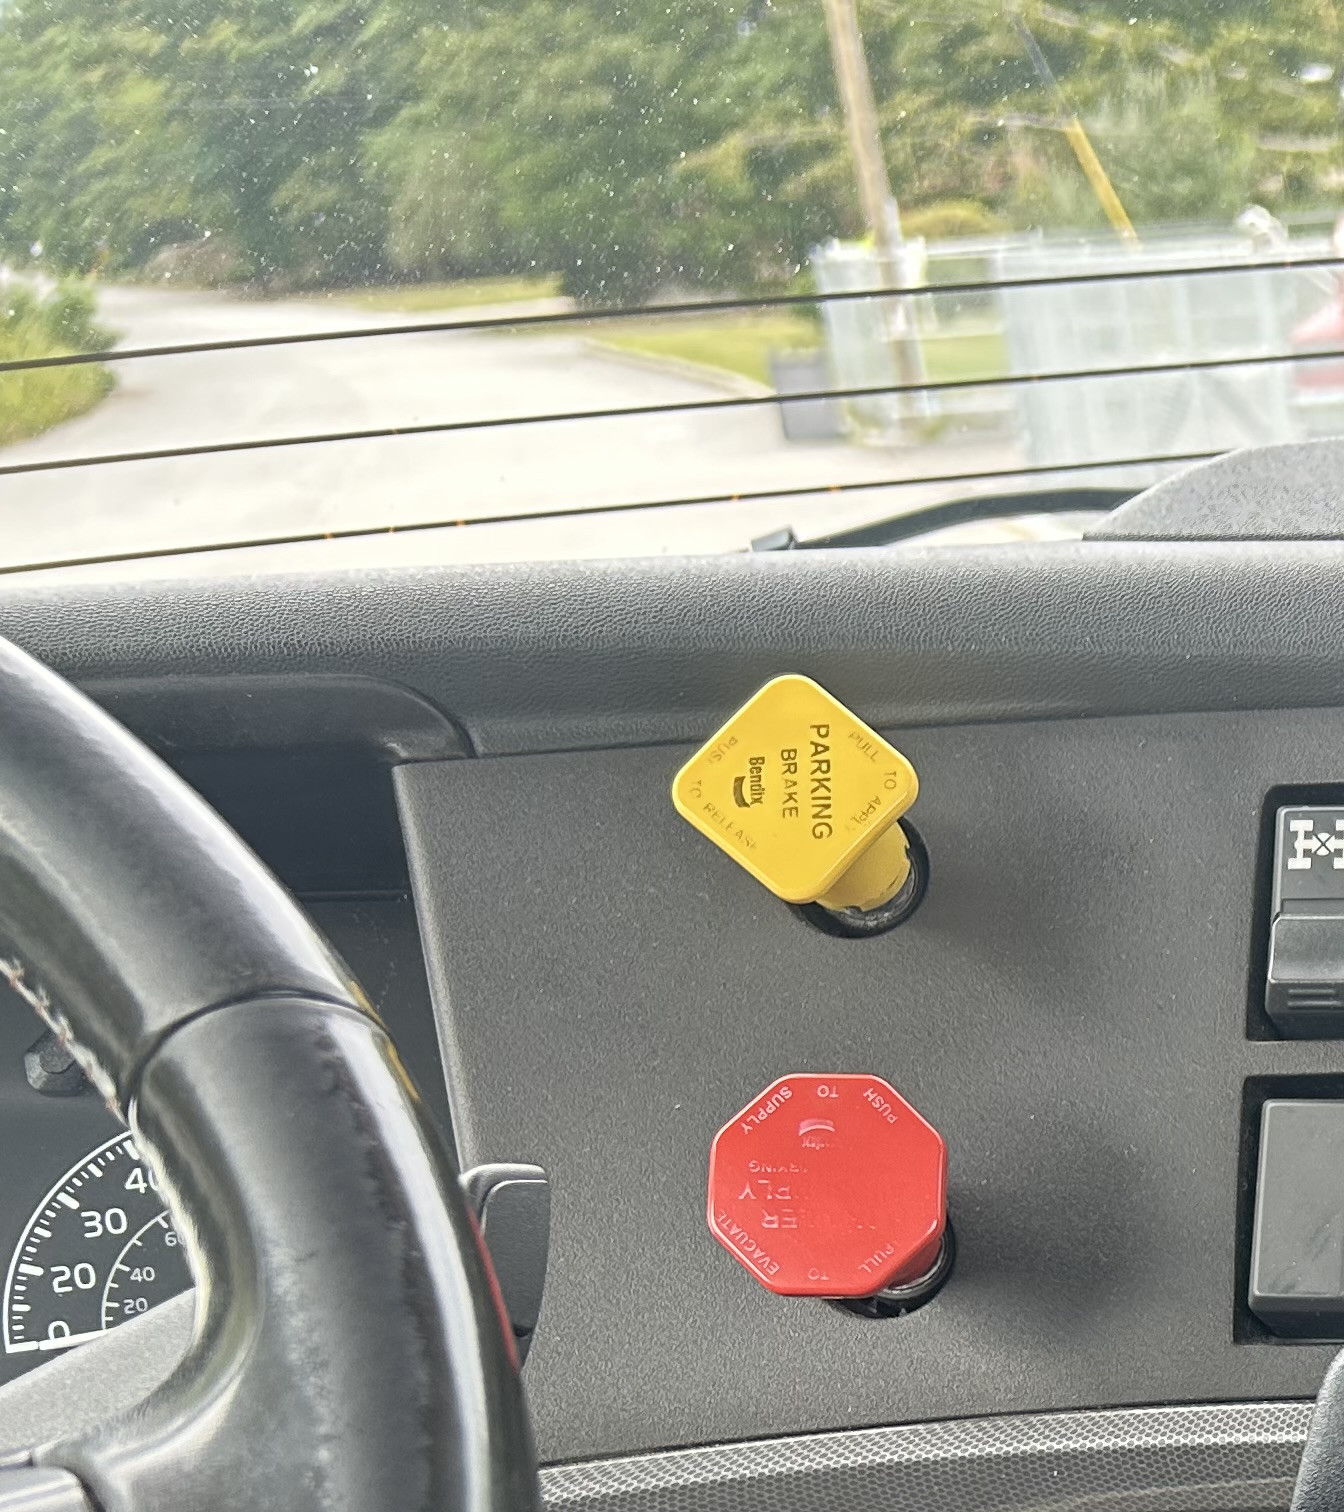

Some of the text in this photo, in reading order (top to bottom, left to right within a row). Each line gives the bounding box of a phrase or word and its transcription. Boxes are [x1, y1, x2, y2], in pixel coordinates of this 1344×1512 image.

[707, 736, 739, 764] PUS
[749, 756, 765, 804] Bendix
[781, 748, 798, 818] BRAKE
[810, 724, 832, 839] PARKING
[844, 731, 897, 832] PULL TO APPL
[740, 1085, 898, 1134] PUSH TO SUPPLY
[81, 1208, 128, 1238] 30
[718, 1209, 780, 1275] EVACUATE
[858, 1243, 895, 1273] PULL
[51, 1263, 96, 1293] 20
[129, 1267, 155, 1282] 40
[808, 1268, 829, 1281] TO
[123, 1298, 148, 1314] 20
